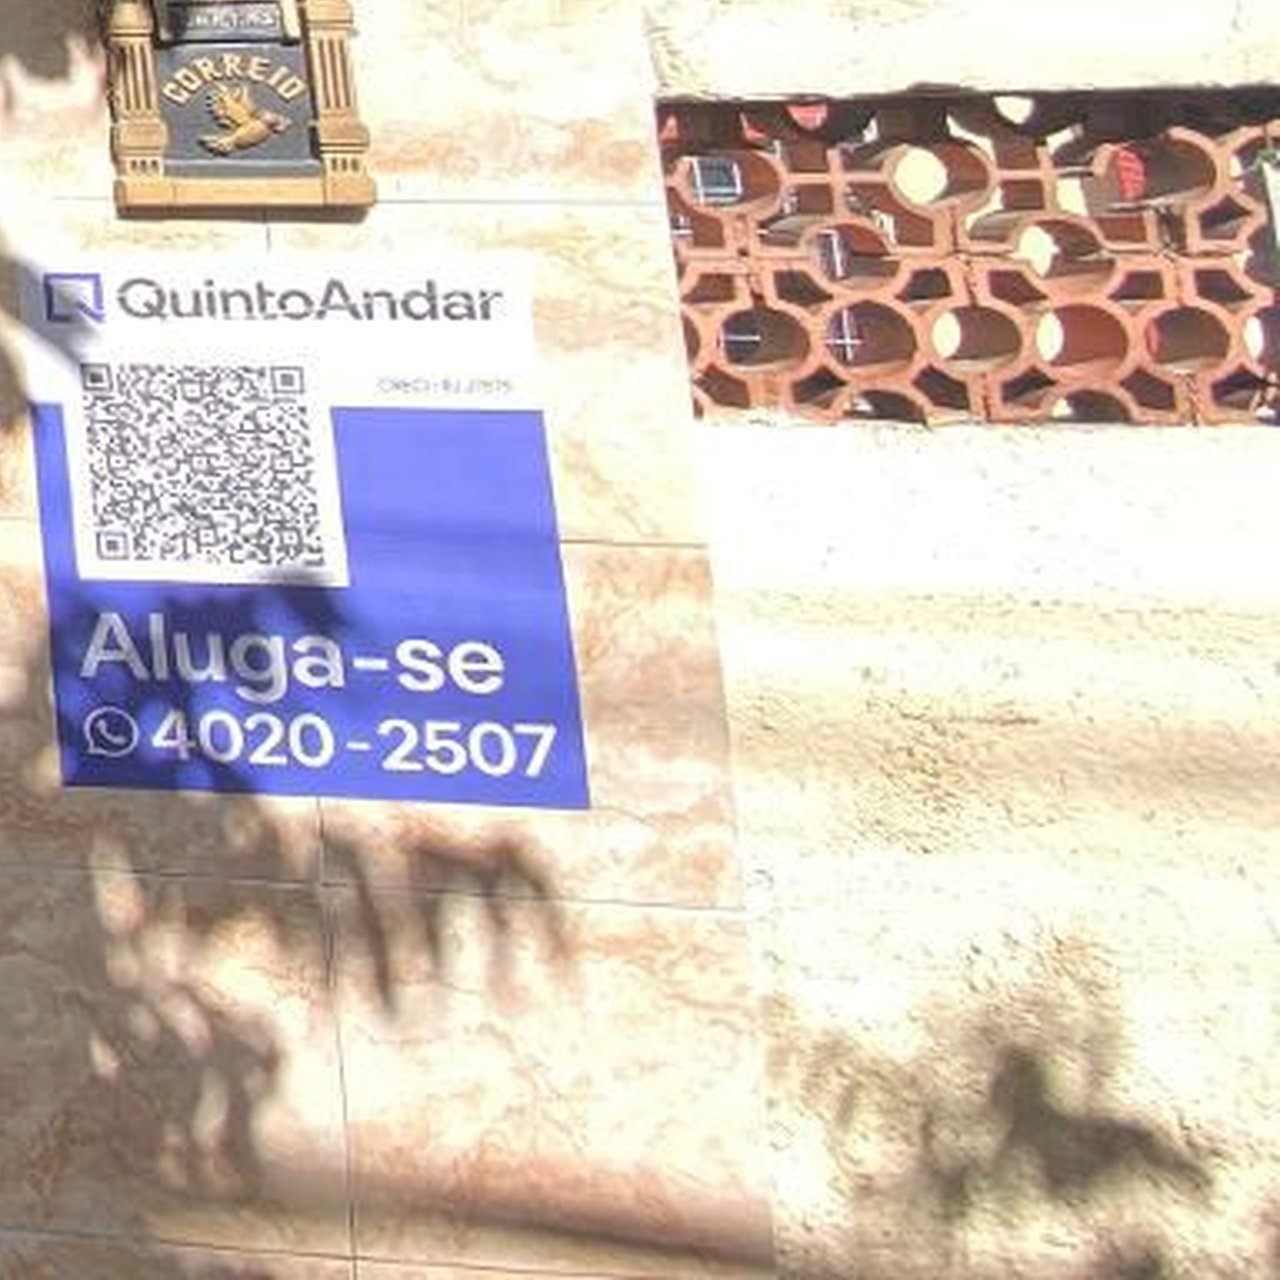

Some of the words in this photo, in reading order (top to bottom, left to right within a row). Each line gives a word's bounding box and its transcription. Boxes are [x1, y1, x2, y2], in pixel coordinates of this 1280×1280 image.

[161, 53, 307, 105] CORREIO
[117, 279, 505, 322] QuintoAndar
[79, 611, 506, 702] Aluga-se
